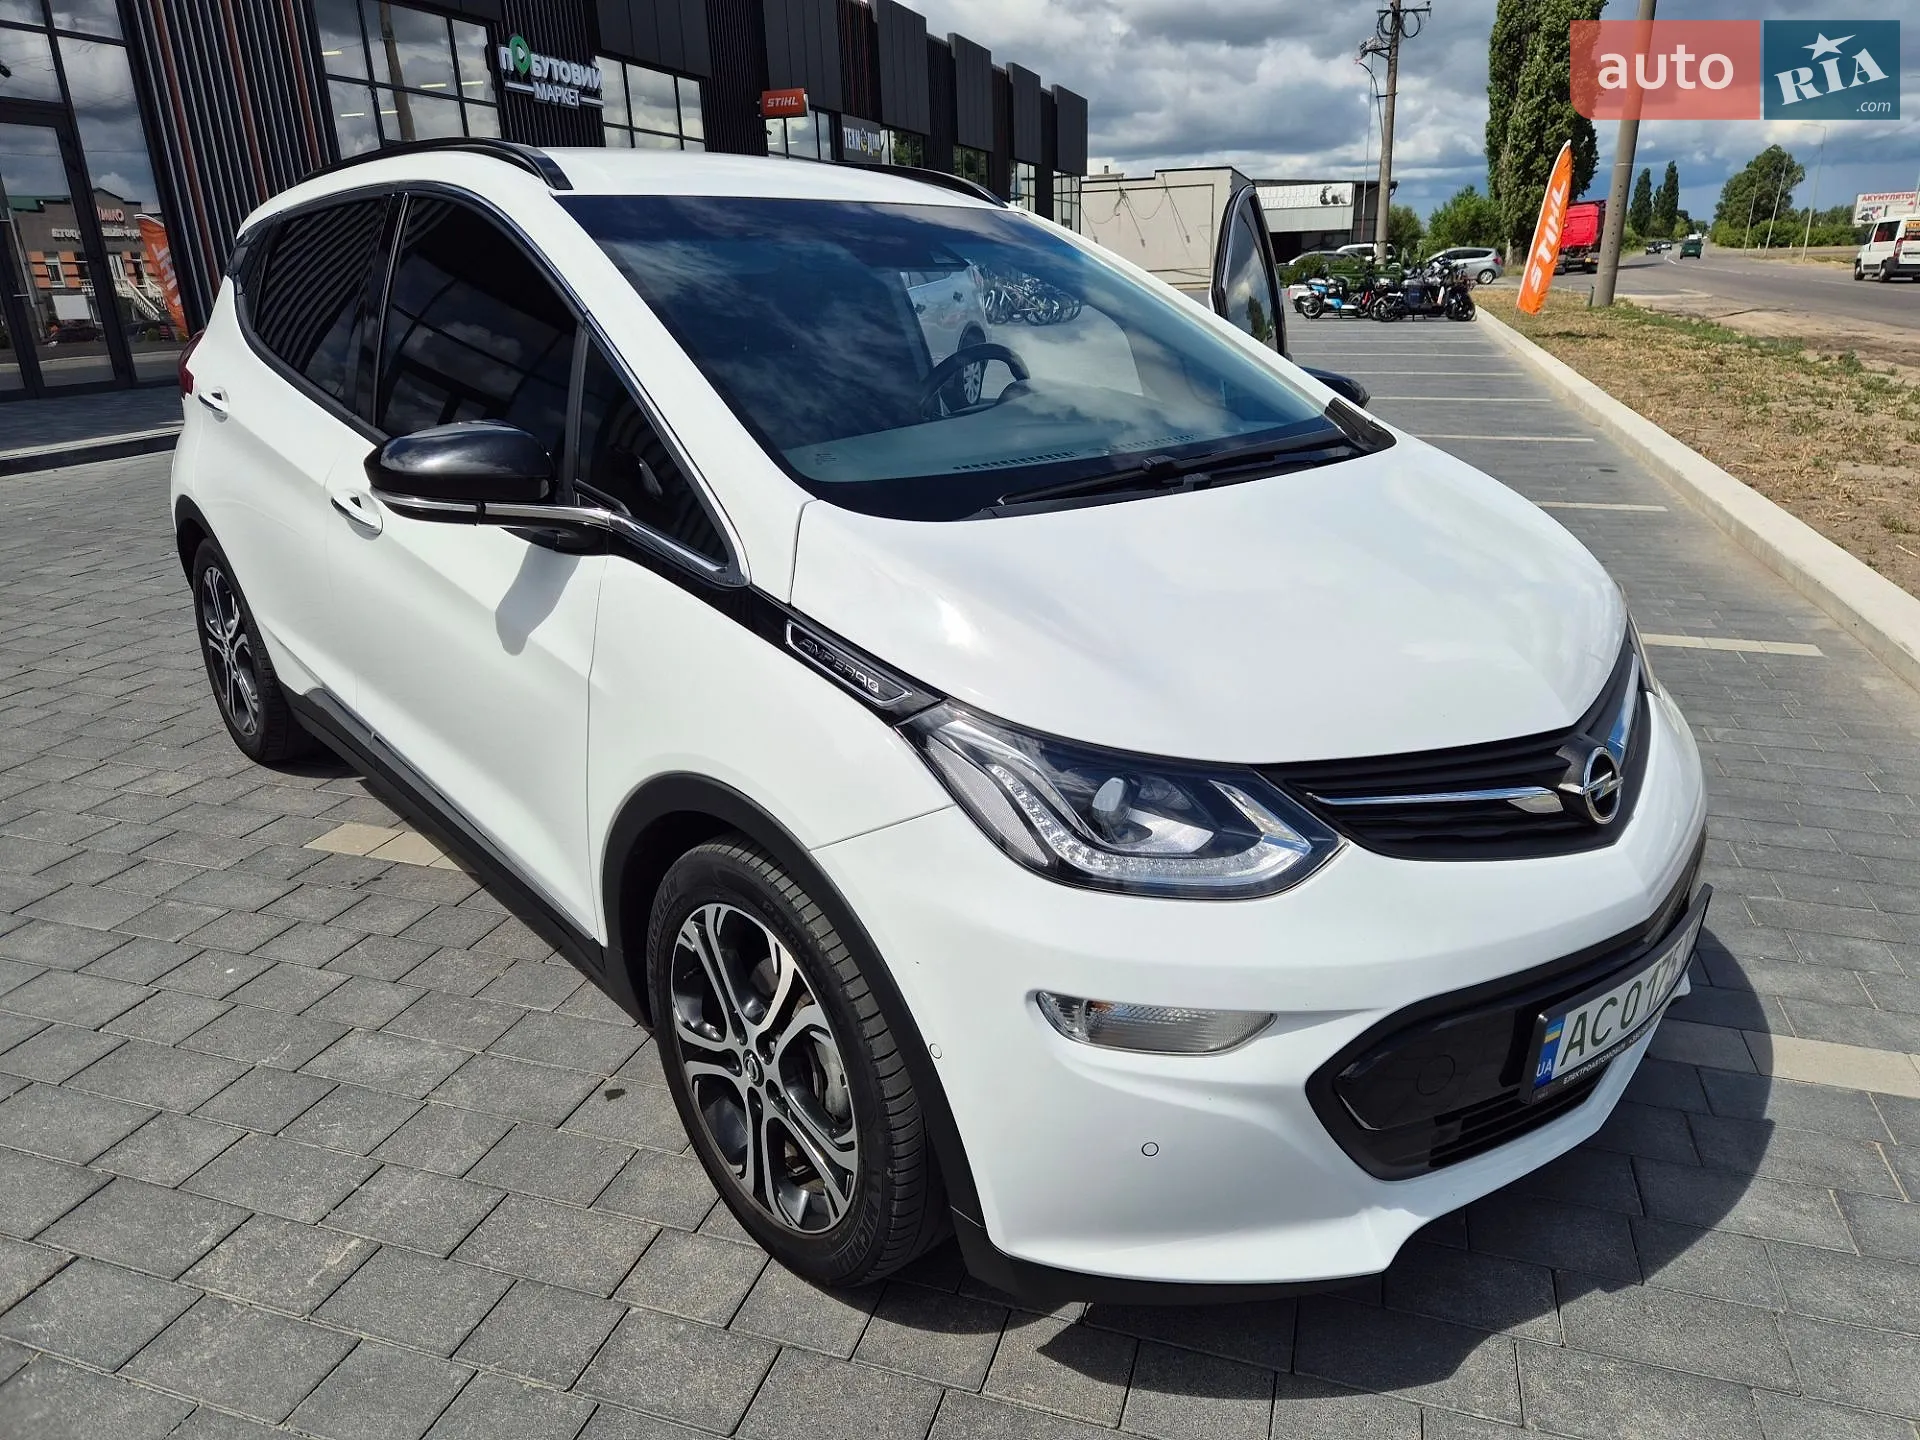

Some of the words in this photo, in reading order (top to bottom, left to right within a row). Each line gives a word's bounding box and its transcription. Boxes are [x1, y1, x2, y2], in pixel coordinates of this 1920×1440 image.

[533, 81, 580, 107] МАРКЕТ
[767, 96, 799, 108] STIHL
[1531, 181, 1567, 294] STIHL
[1536, 1058, 1552, 1077] UA
